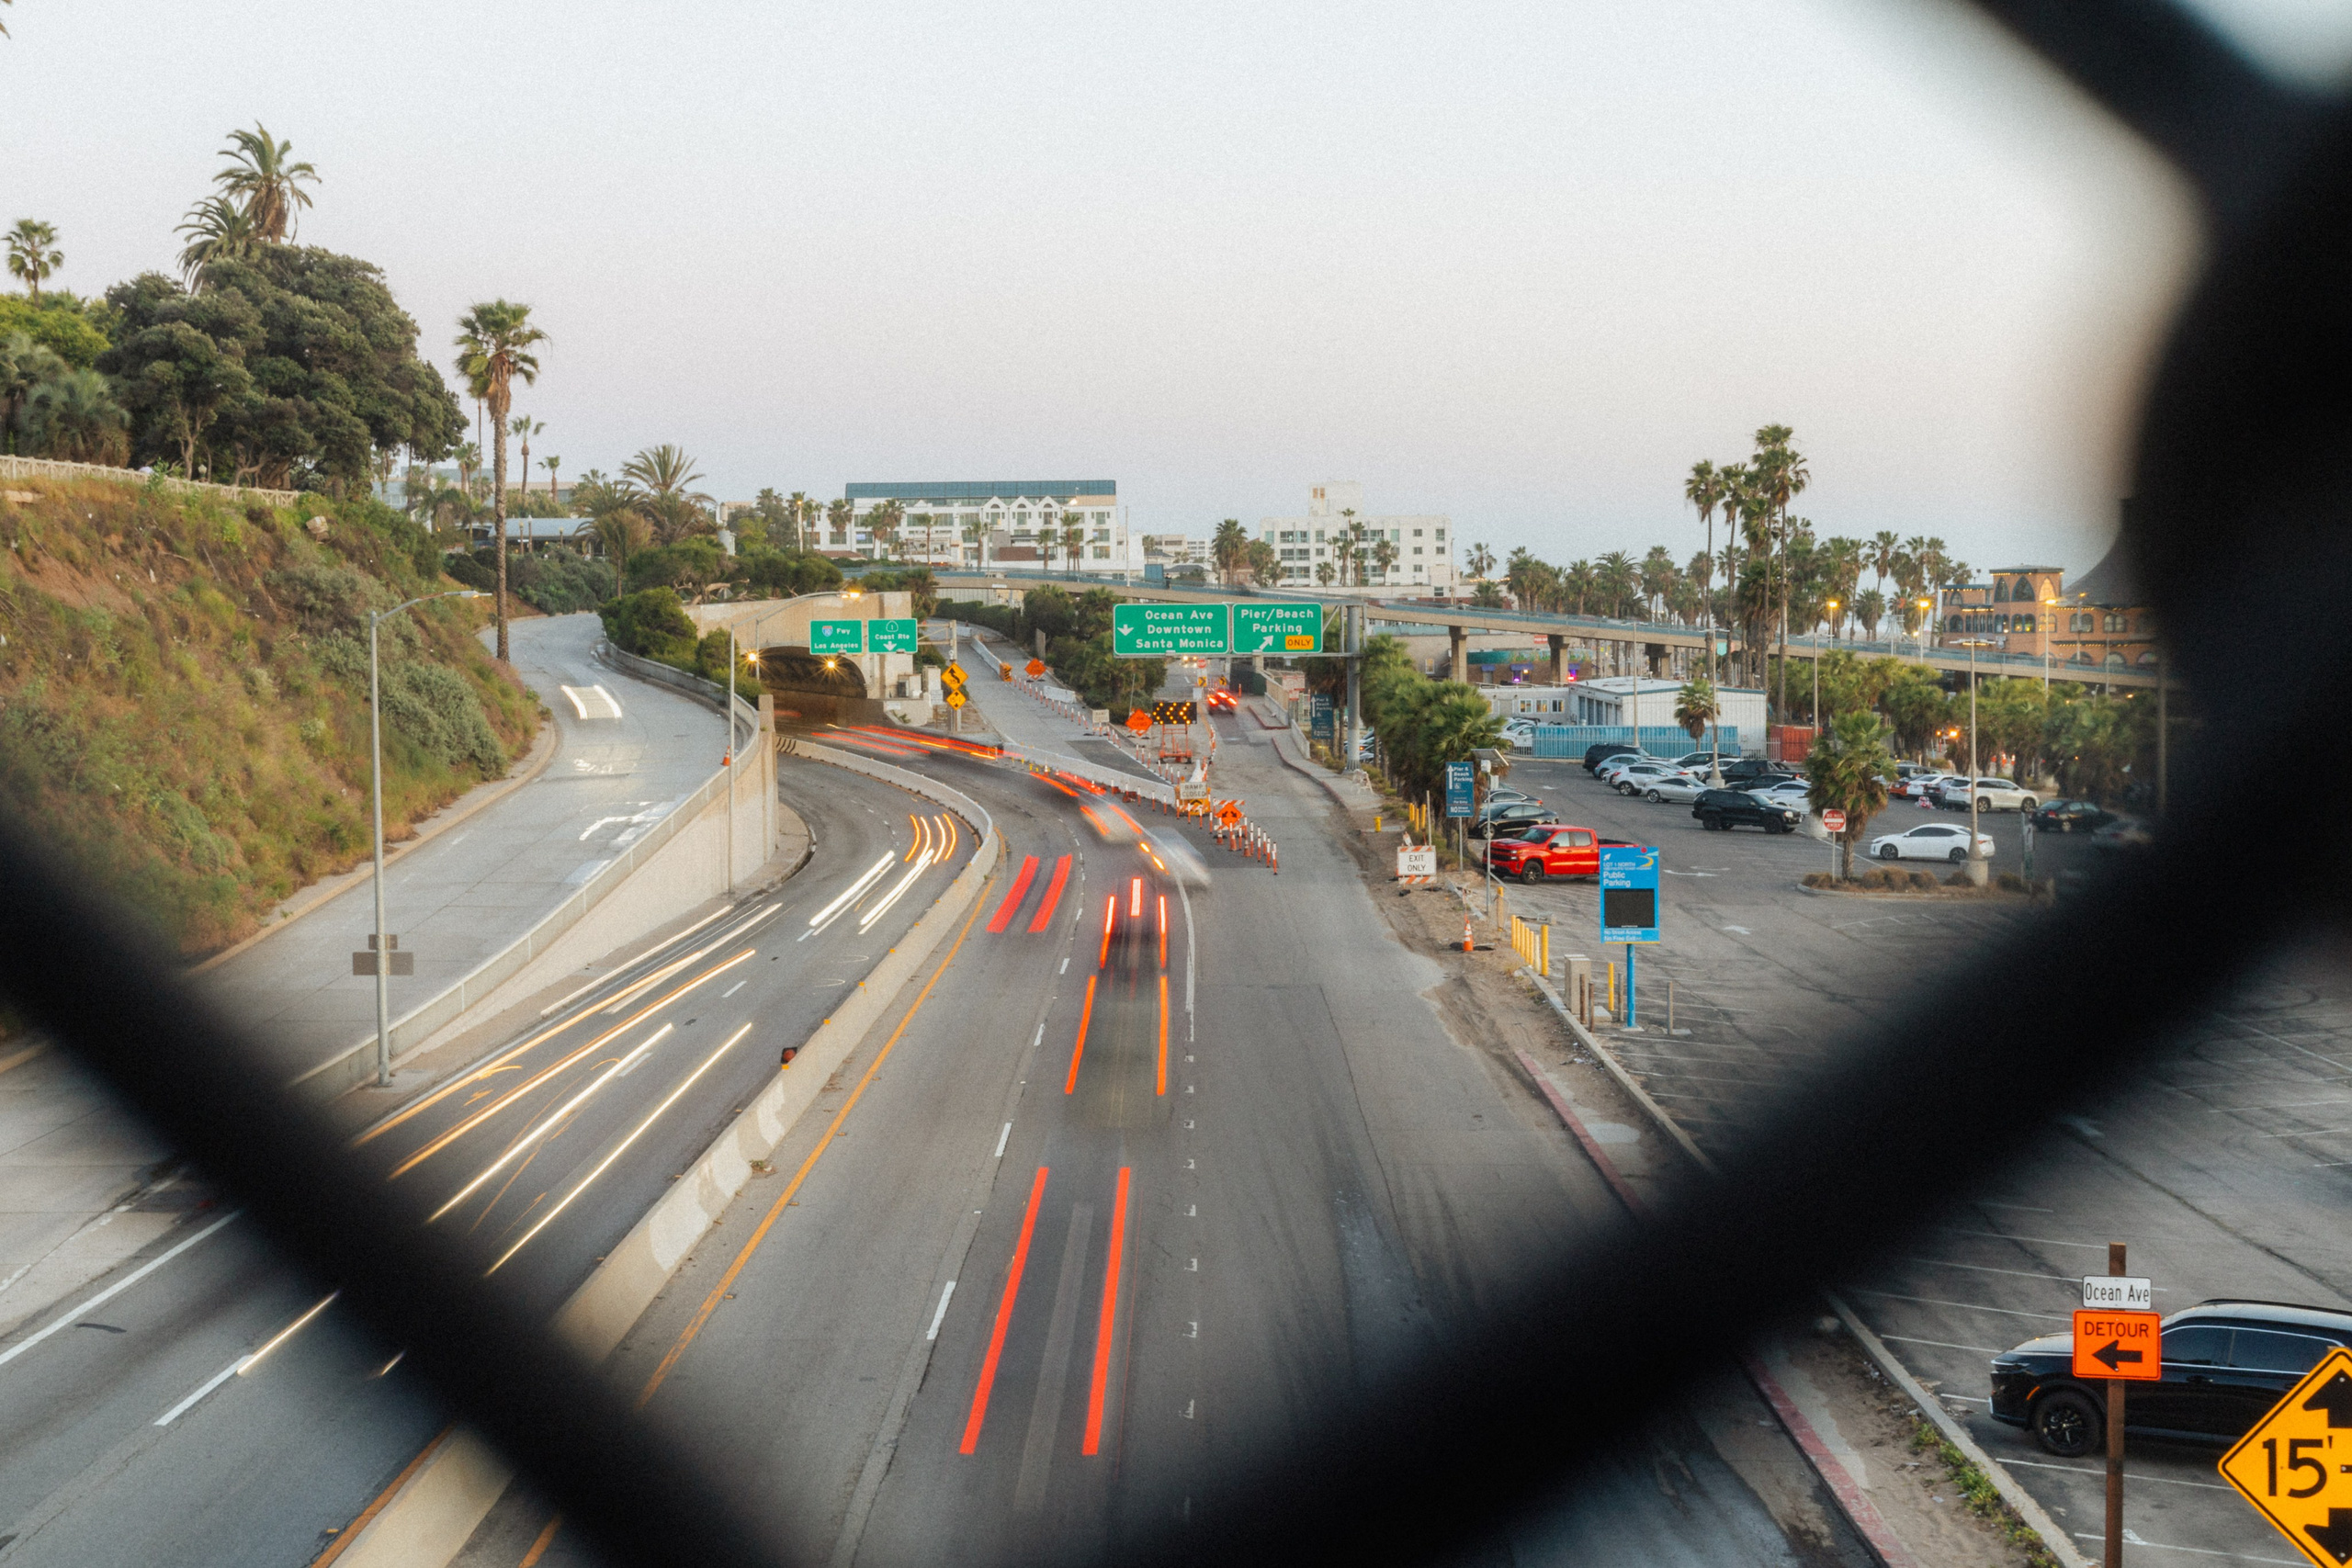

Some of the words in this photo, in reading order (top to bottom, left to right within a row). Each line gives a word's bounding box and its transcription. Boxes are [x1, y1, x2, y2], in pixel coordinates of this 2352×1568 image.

[1145, 610, 1183, 620] Ocean
[1190, 610, 1214, 620] Ave
[1240, 608, 1314, 622] Pier/Beach
[1147, 625, 1212, 635] Downtown
[1252, 623, 1303, 636] Parking
[1136, 638, 1173, 649] Santa
[1179, 638, 1224, 649] Monica
[1287, 638, 1312, 647] ONLY
[1408, 854, 1424, 863] EXIT
[1603, 871, 1625, 879] Public
[1603, 878, 1631, 888] Parking
[2085, 1282, 2122, 1302] Ocean
[2127, 1284, 2150, 1303] Ave
[2084, 1321, 2149, 1338] DETOUR
